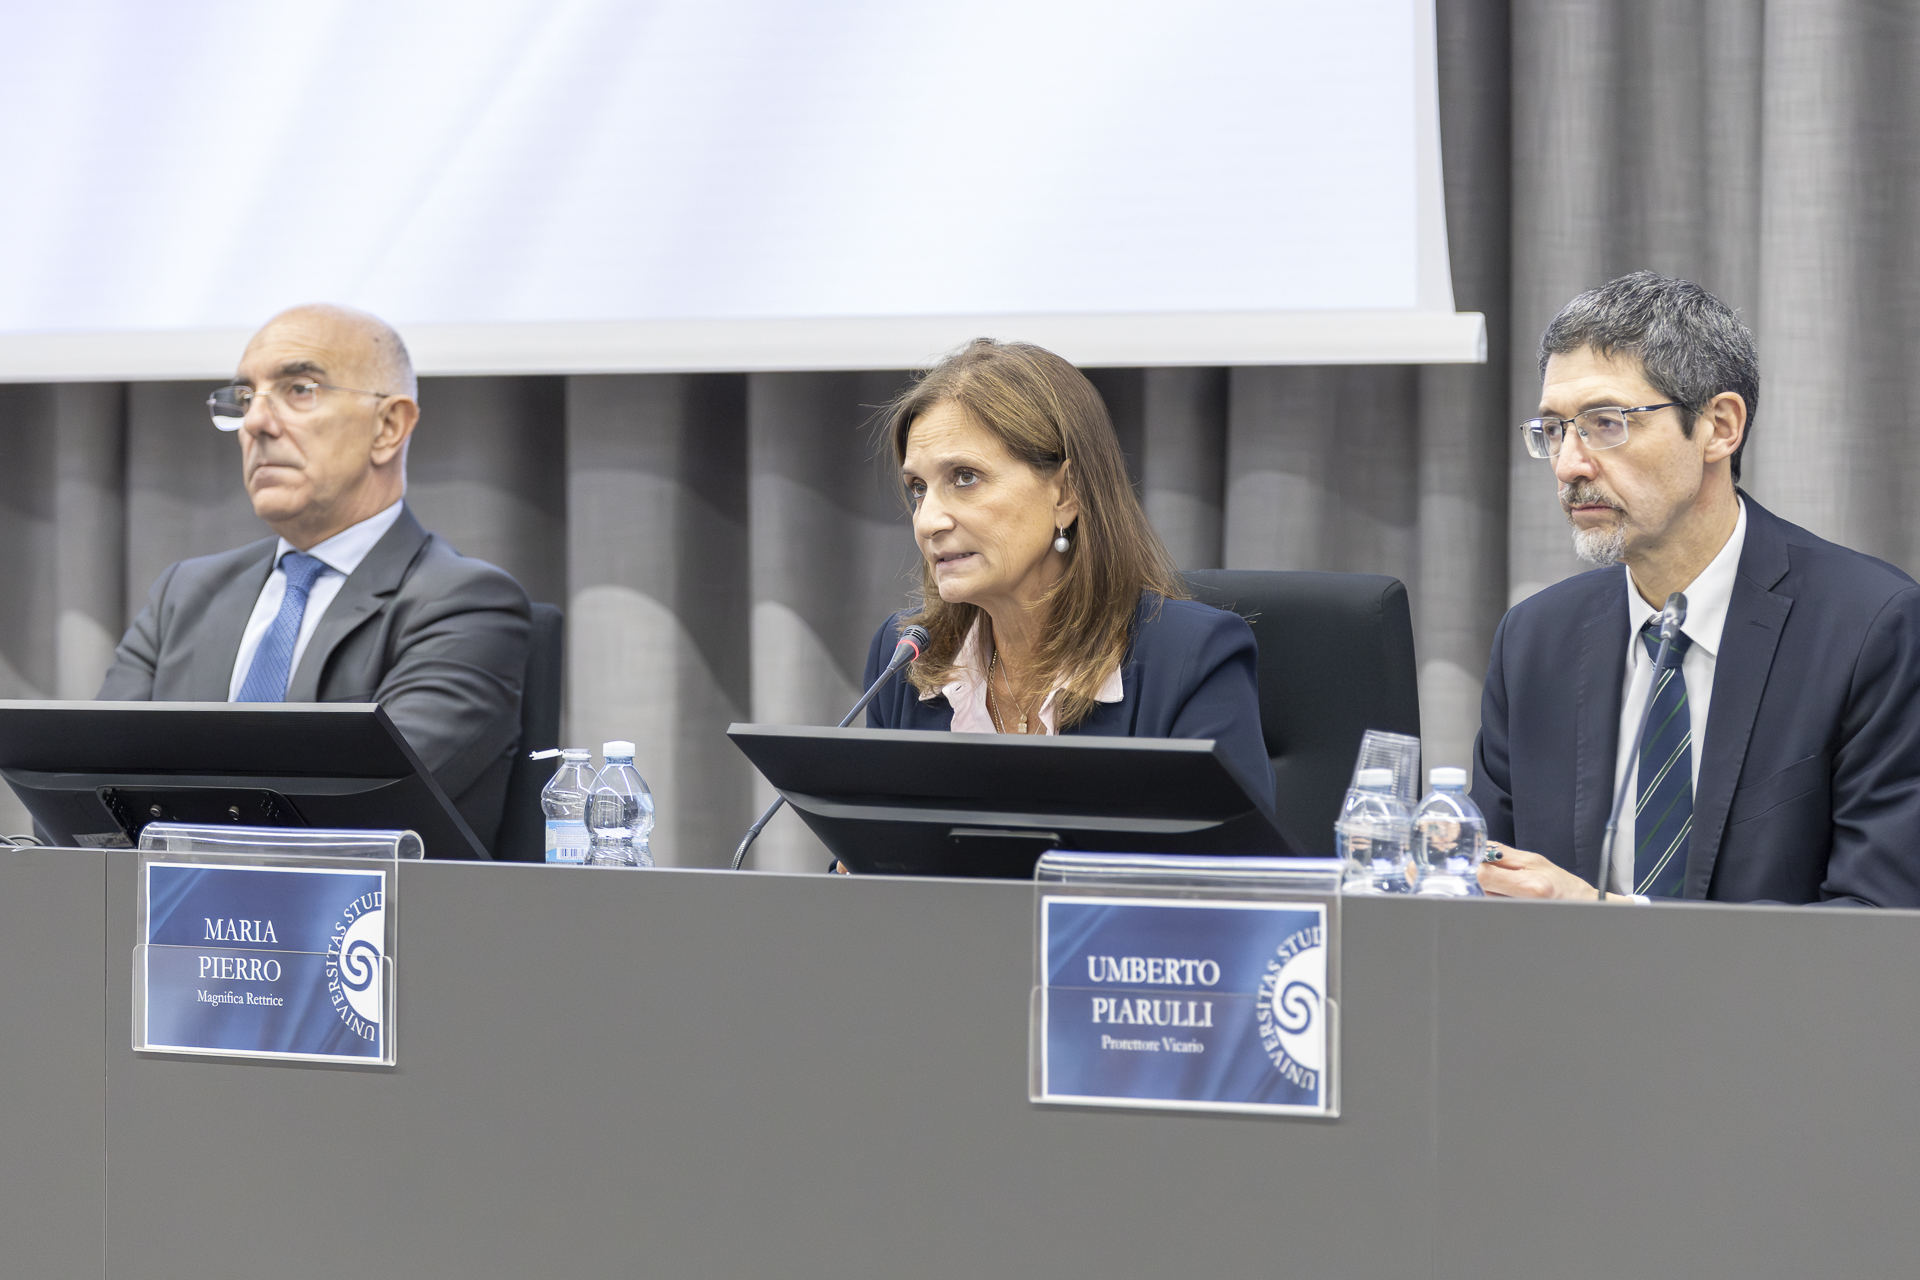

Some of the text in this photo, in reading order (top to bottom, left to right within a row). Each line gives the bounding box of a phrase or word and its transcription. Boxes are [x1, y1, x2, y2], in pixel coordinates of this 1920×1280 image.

[203, 917, 278, 943] MARIA
[198, 956, 282, 982] PIERRO
[326, 922, 375, 1041] UNIVERSITAS
[1087, 955, 1221, 986] UMBERTO
[197, 989, 283, 1007] Magnifica Rettrice
[1092, 997, 1213, 1028] PIARULLI
[1256, 959, 1316, 1091] UNIVERSITAS
[1101, 1034, 1204, 1053] Prorettore Vicario
